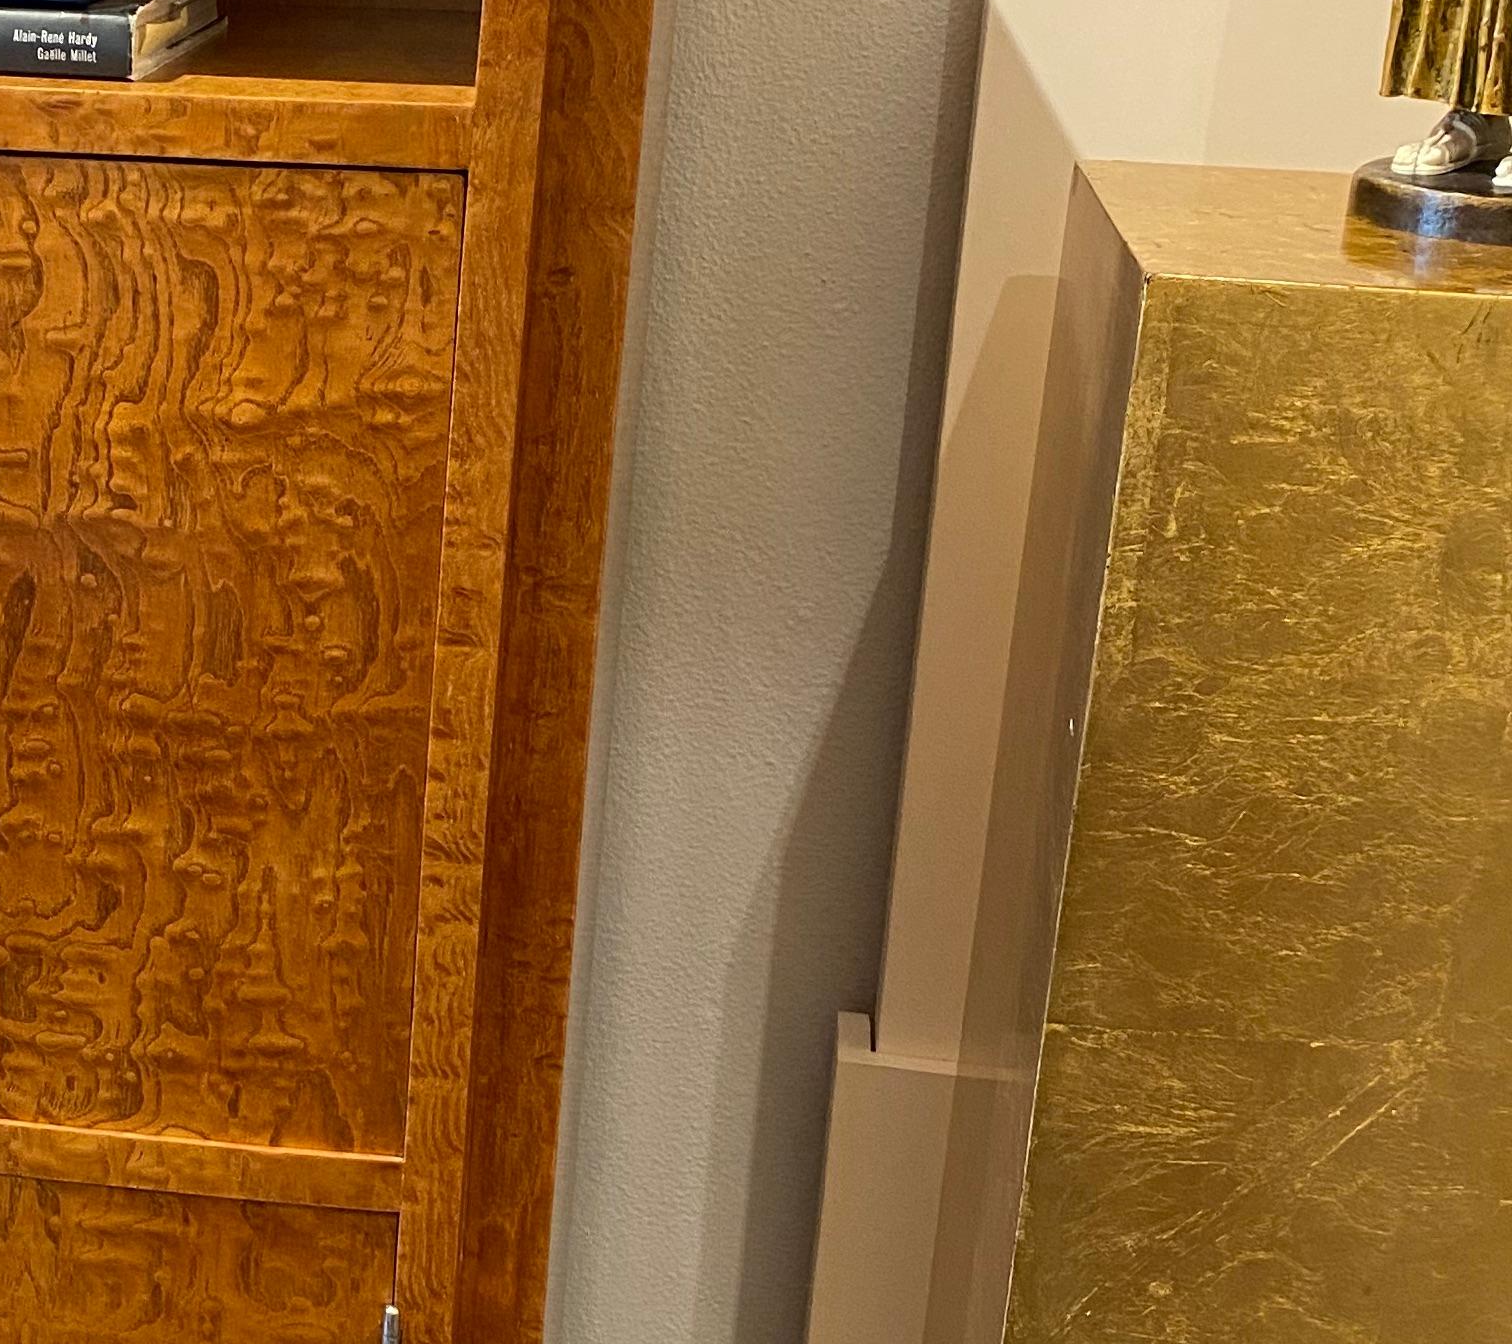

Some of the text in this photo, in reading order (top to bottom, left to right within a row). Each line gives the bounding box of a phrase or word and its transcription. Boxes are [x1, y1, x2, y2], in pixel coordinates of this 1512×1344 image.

[12, 28, 98, 49] Alain-René Hardy
[37, 46, 97, 64] Gaëlle Millet
